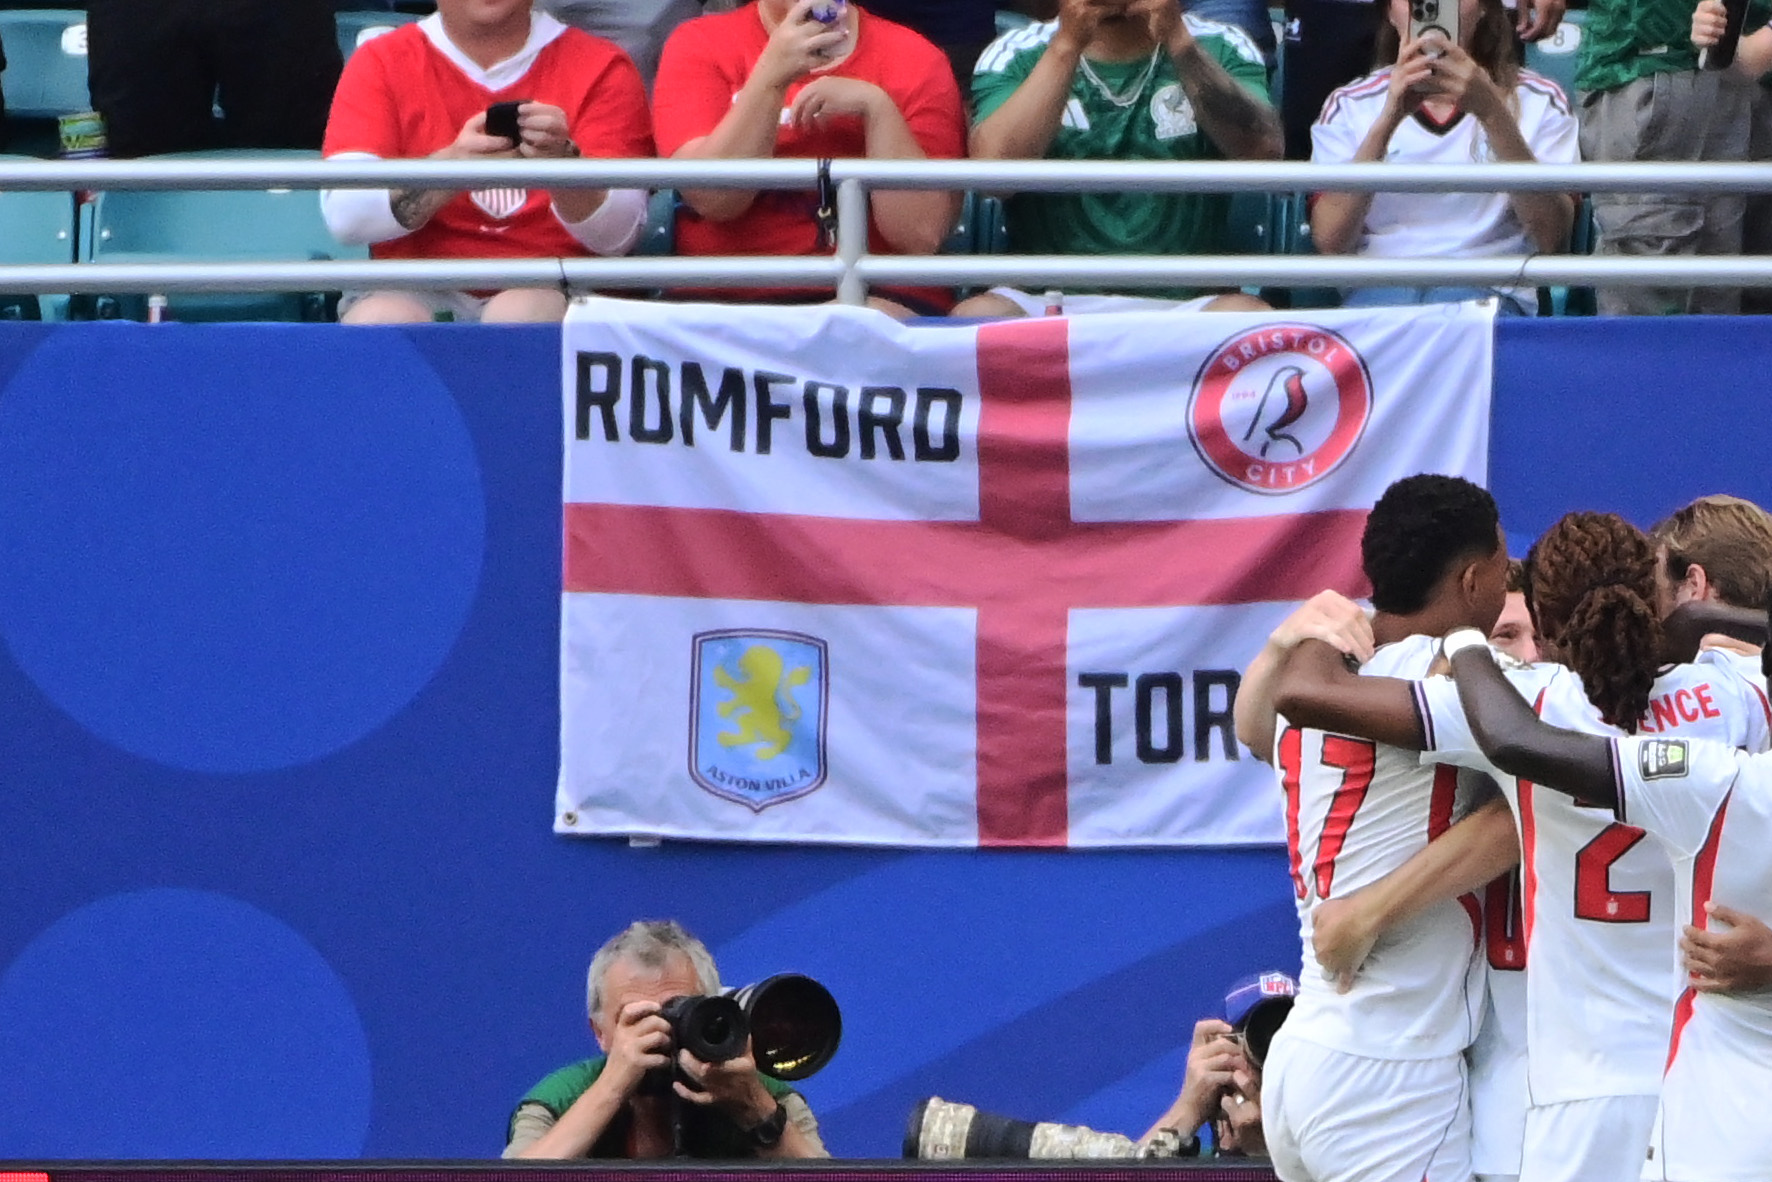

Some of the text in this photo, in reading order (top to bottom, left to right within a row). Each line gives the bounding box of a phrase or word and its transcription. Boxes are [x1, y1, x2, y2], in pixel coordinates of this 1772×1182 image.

[1223, 332, 1338, 371] BRISTOL
[575, 350, 963, 463] ROMFORD
[1246, 458, 1316, 485] CITY
[1078, 669, 1242, 765] TOR
[706, 765, 760, 791] ASTON
[1278, 727, 1376, 900] 17
